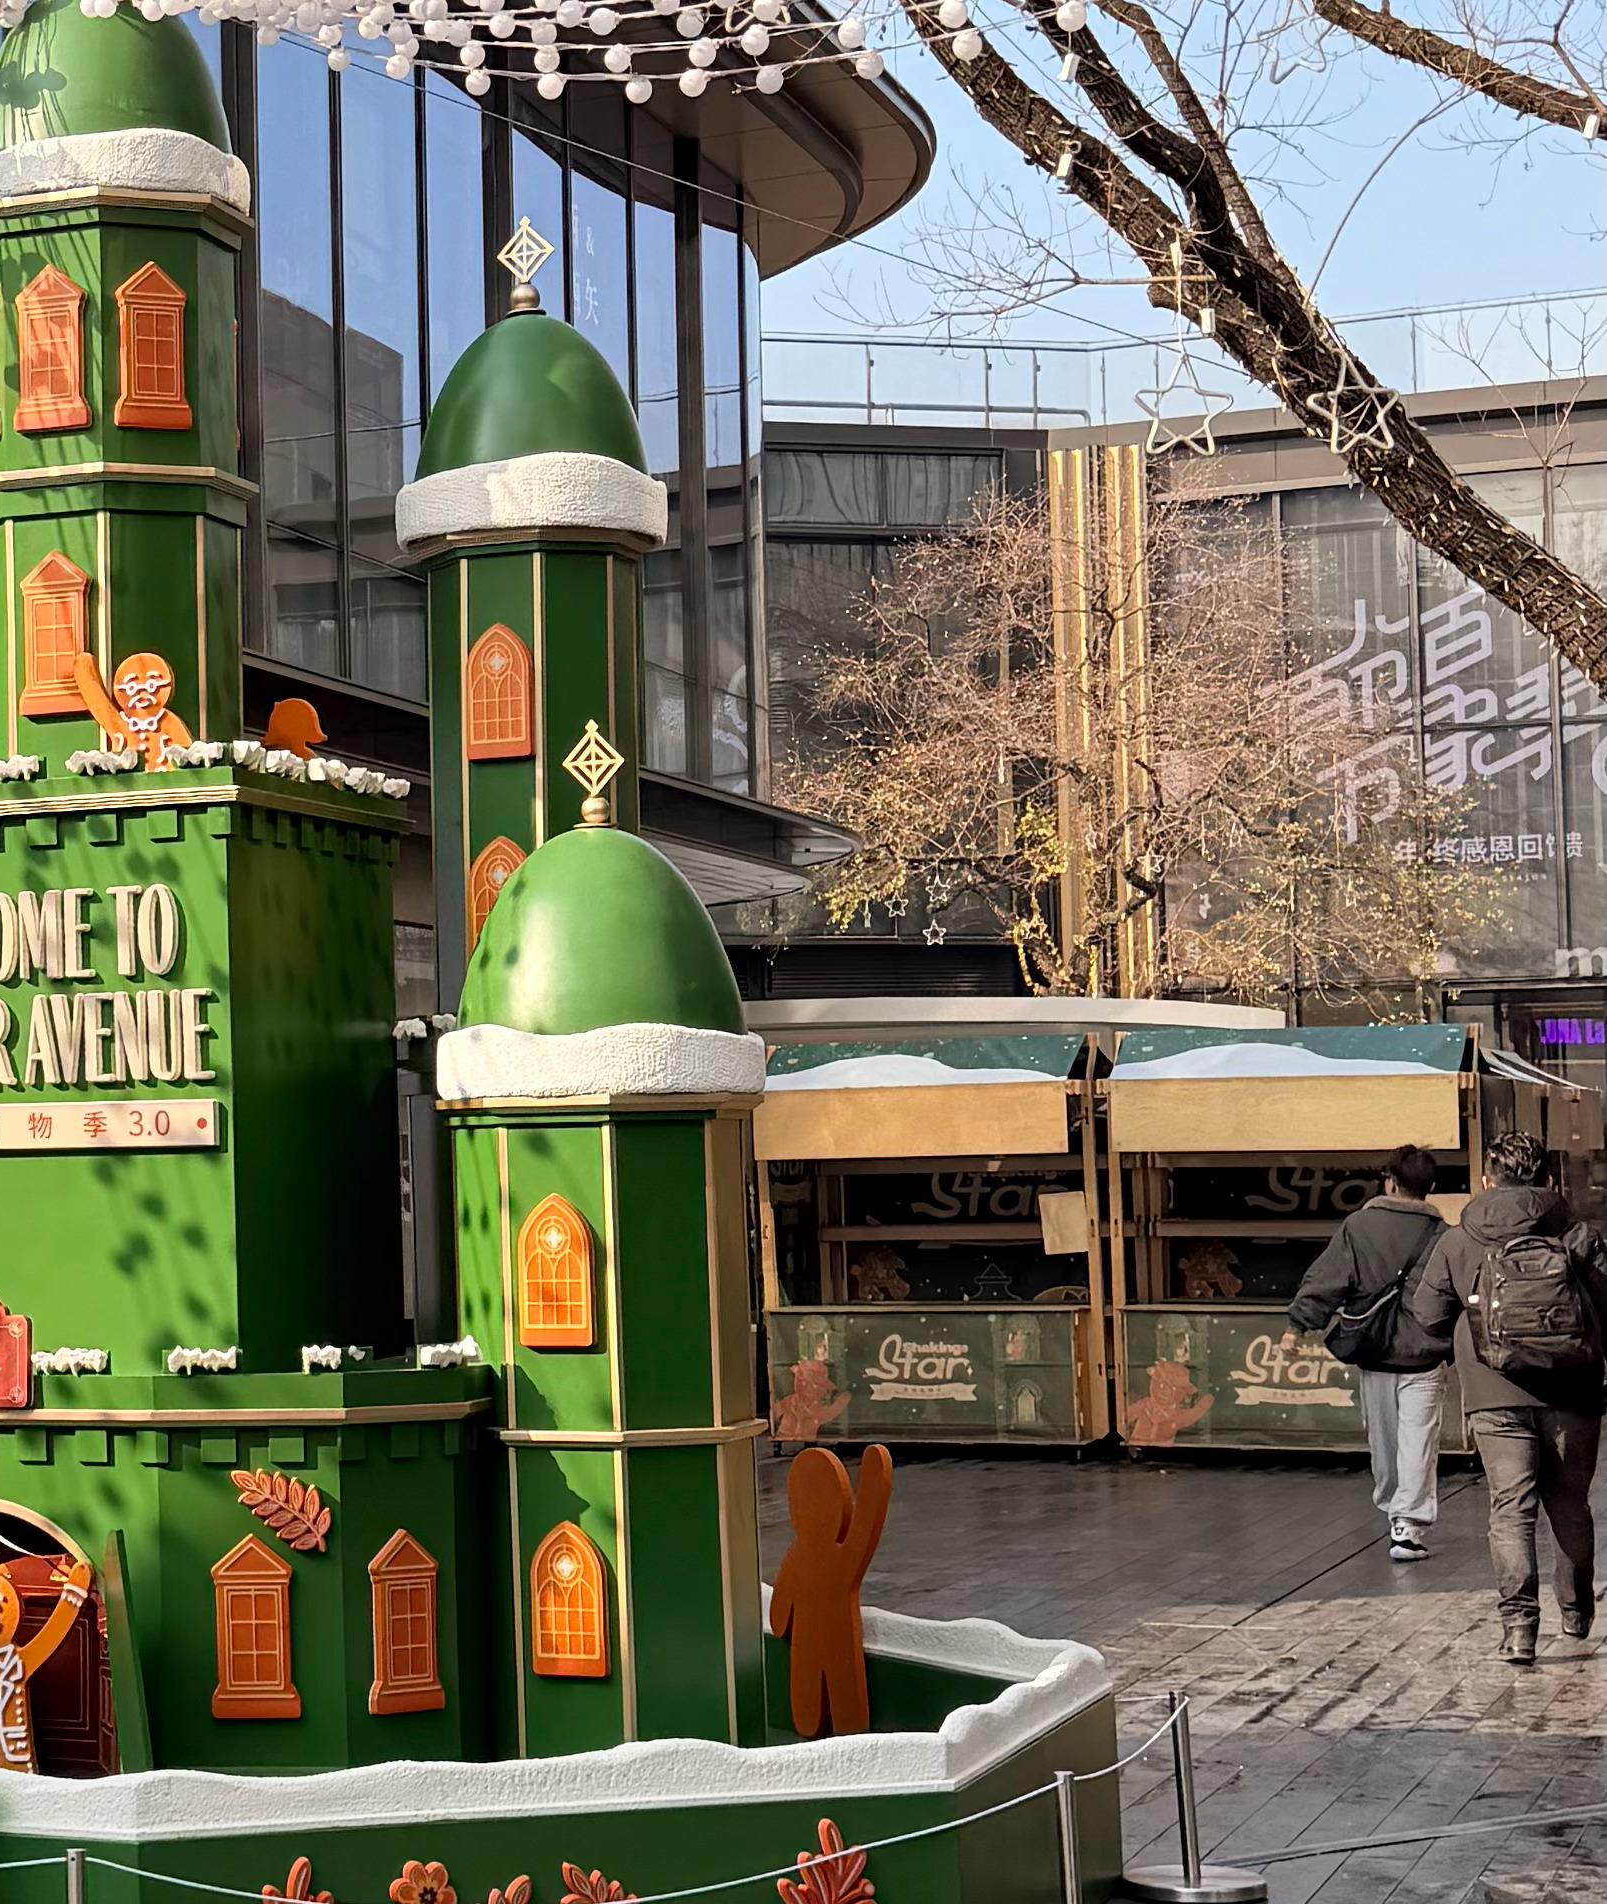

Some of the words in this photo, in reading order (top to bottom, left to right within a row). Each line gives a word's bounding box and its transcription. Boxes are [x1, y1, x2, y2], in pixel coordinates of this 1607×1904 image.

[106, 882, 180, 979] TO
[25, 987, 217, 1087] AVENUE
[128, 1109, 171, 1138] 3.0
[864, 1334, 971, 1379] Star
[1230, 1335, 1348, 1384] Star
